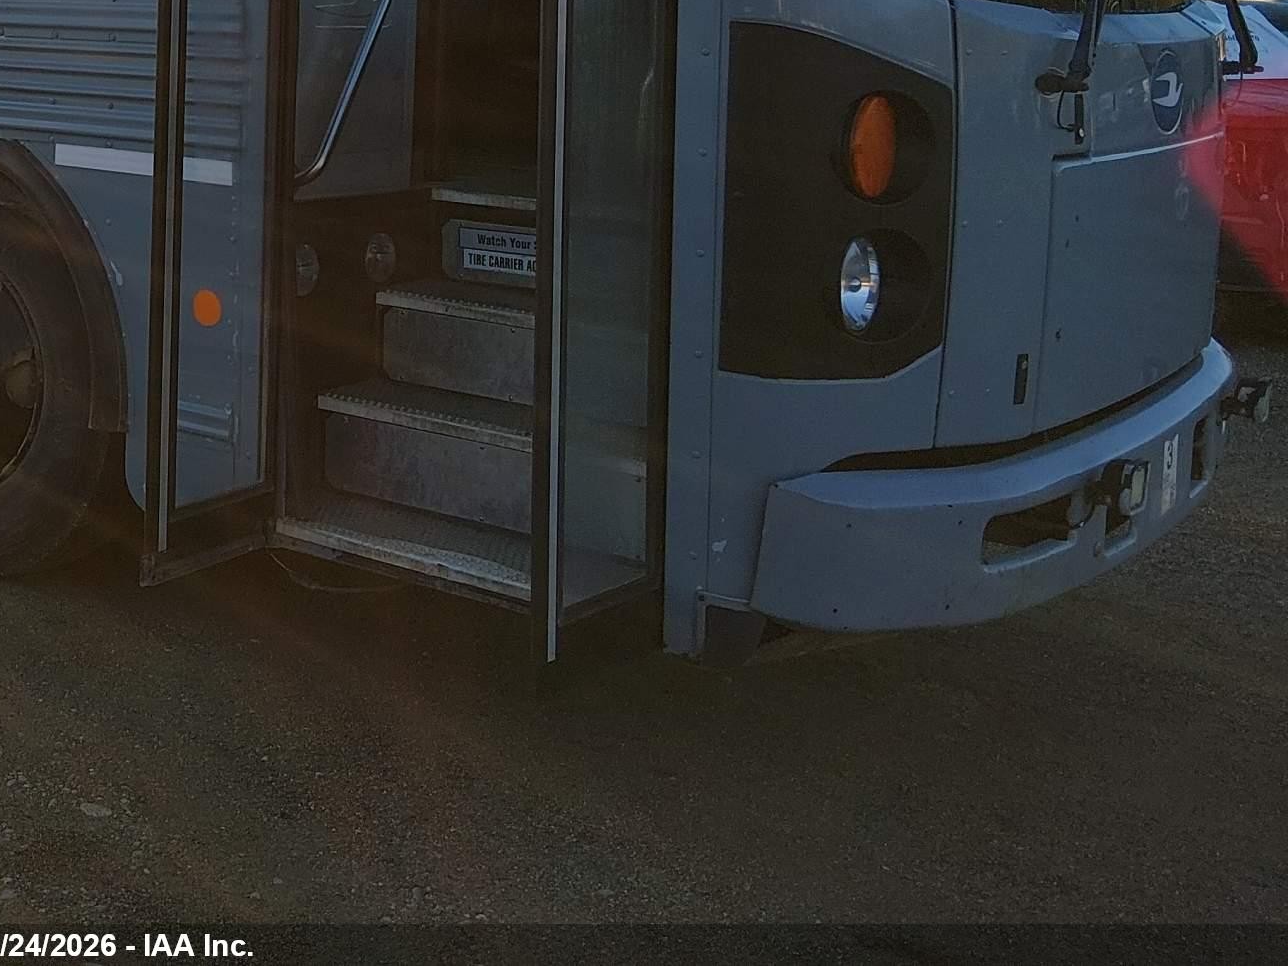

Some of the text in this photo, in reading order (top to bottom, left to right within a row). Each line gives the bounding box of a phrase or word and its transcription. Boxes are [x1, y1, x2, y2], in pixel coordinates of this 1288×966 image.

[477, 234, 506, 248] Watch
[509, 237, 531, 249] Your
[488, 255, 524, 270] CARRIER
